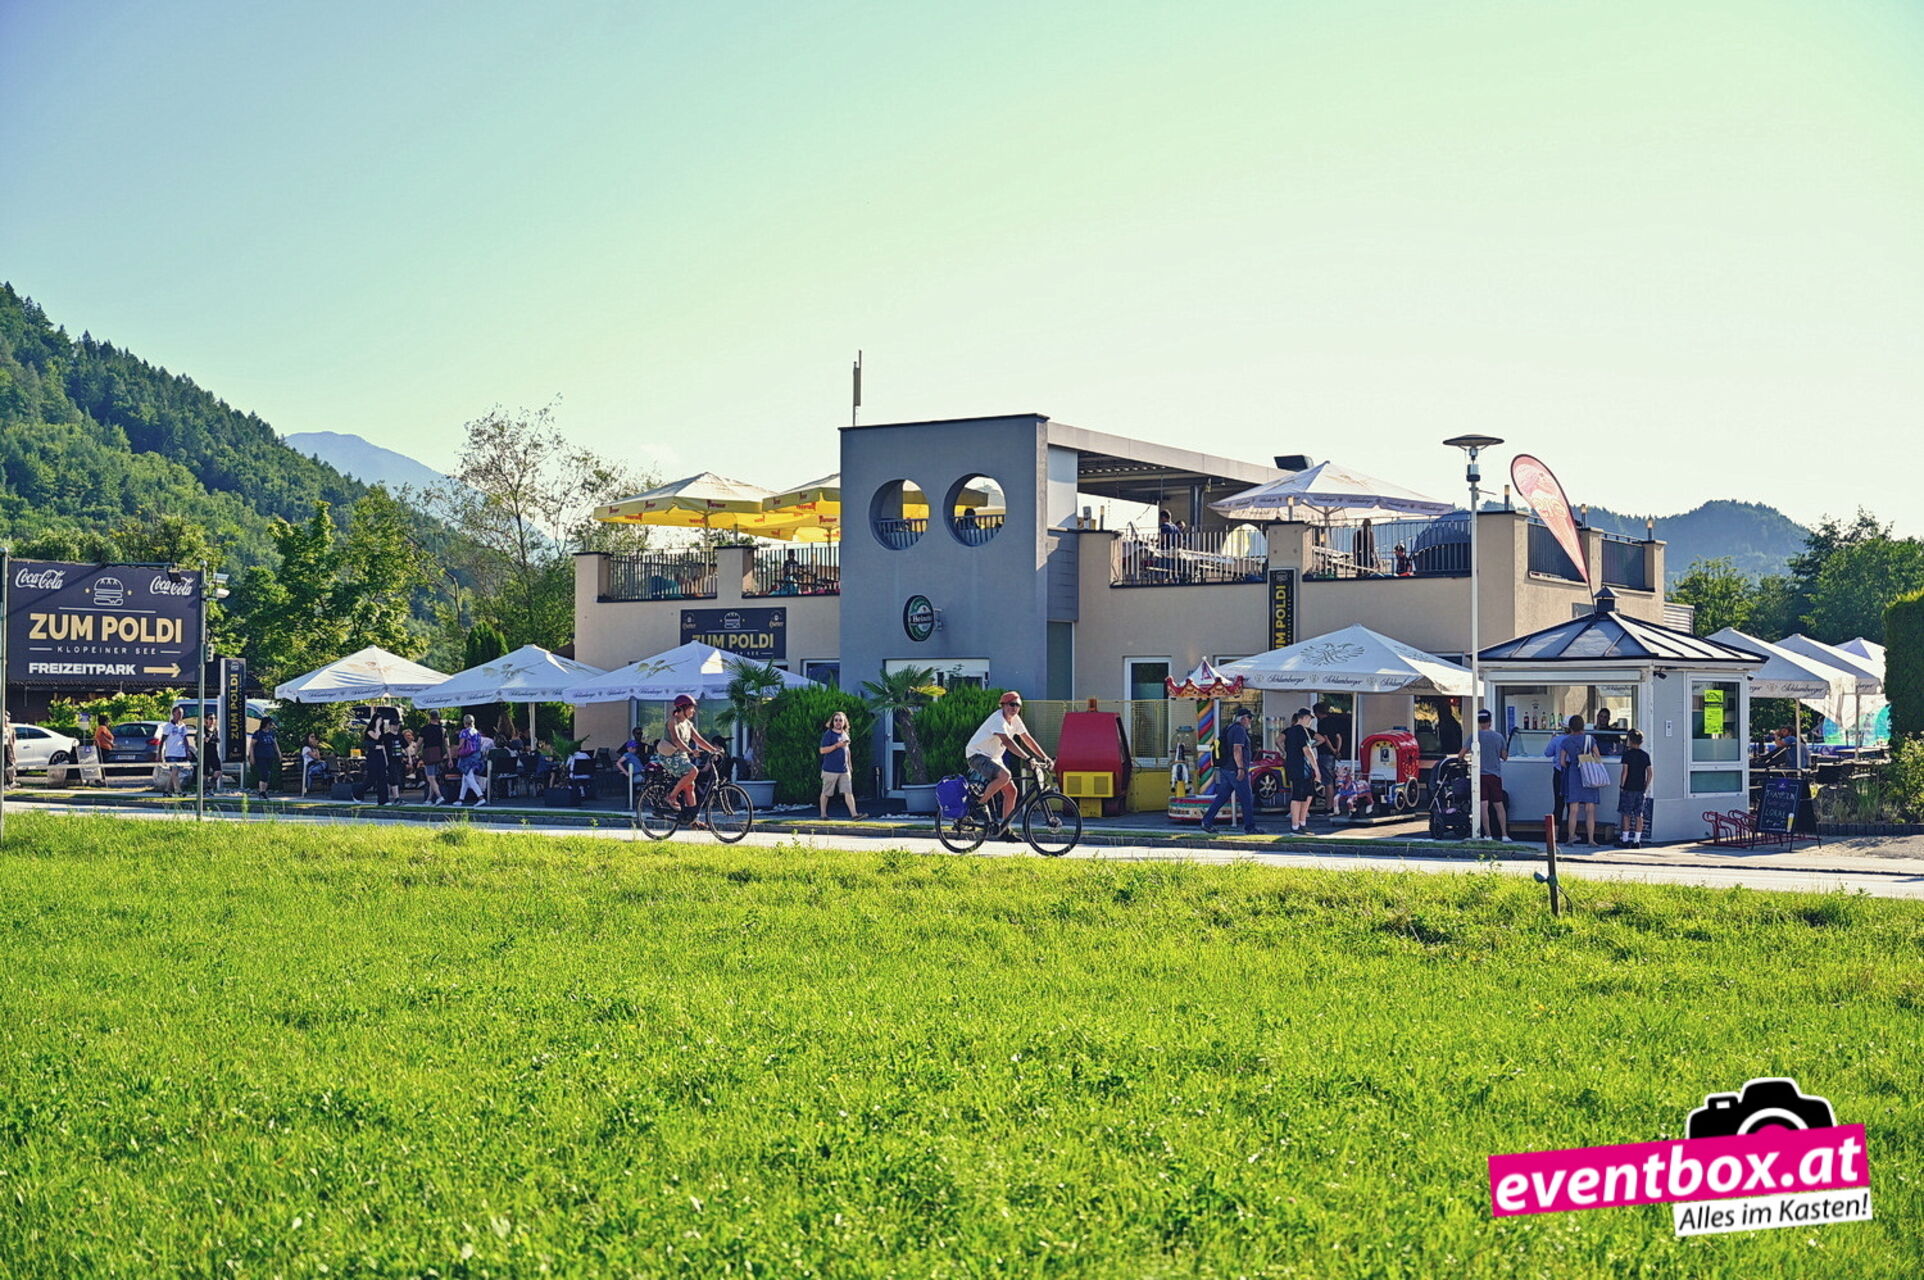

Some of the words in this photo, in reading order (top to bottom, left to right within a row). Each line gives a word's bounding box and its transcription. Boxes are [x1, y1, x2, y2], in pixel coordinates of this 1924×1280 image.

[15, 567, 66, 589] Coca-Cola
[149, 575, 195, 596] CocaCola
[1275, 585, 1286, 629] POLDI
[29, 613, 93, 641] ZUM
[101, 615, 182, 644] POLDI
[57, 646, 127, 655] KLOPEINER
[135, 647, 156, 655] SEE
[729, 633, 774, 648] POLDI
[29, 662, 136, 676] FREIZEITPARK
[230, 673, 239, 710] POLDI
[230, 713, 239, 740] ZUM
